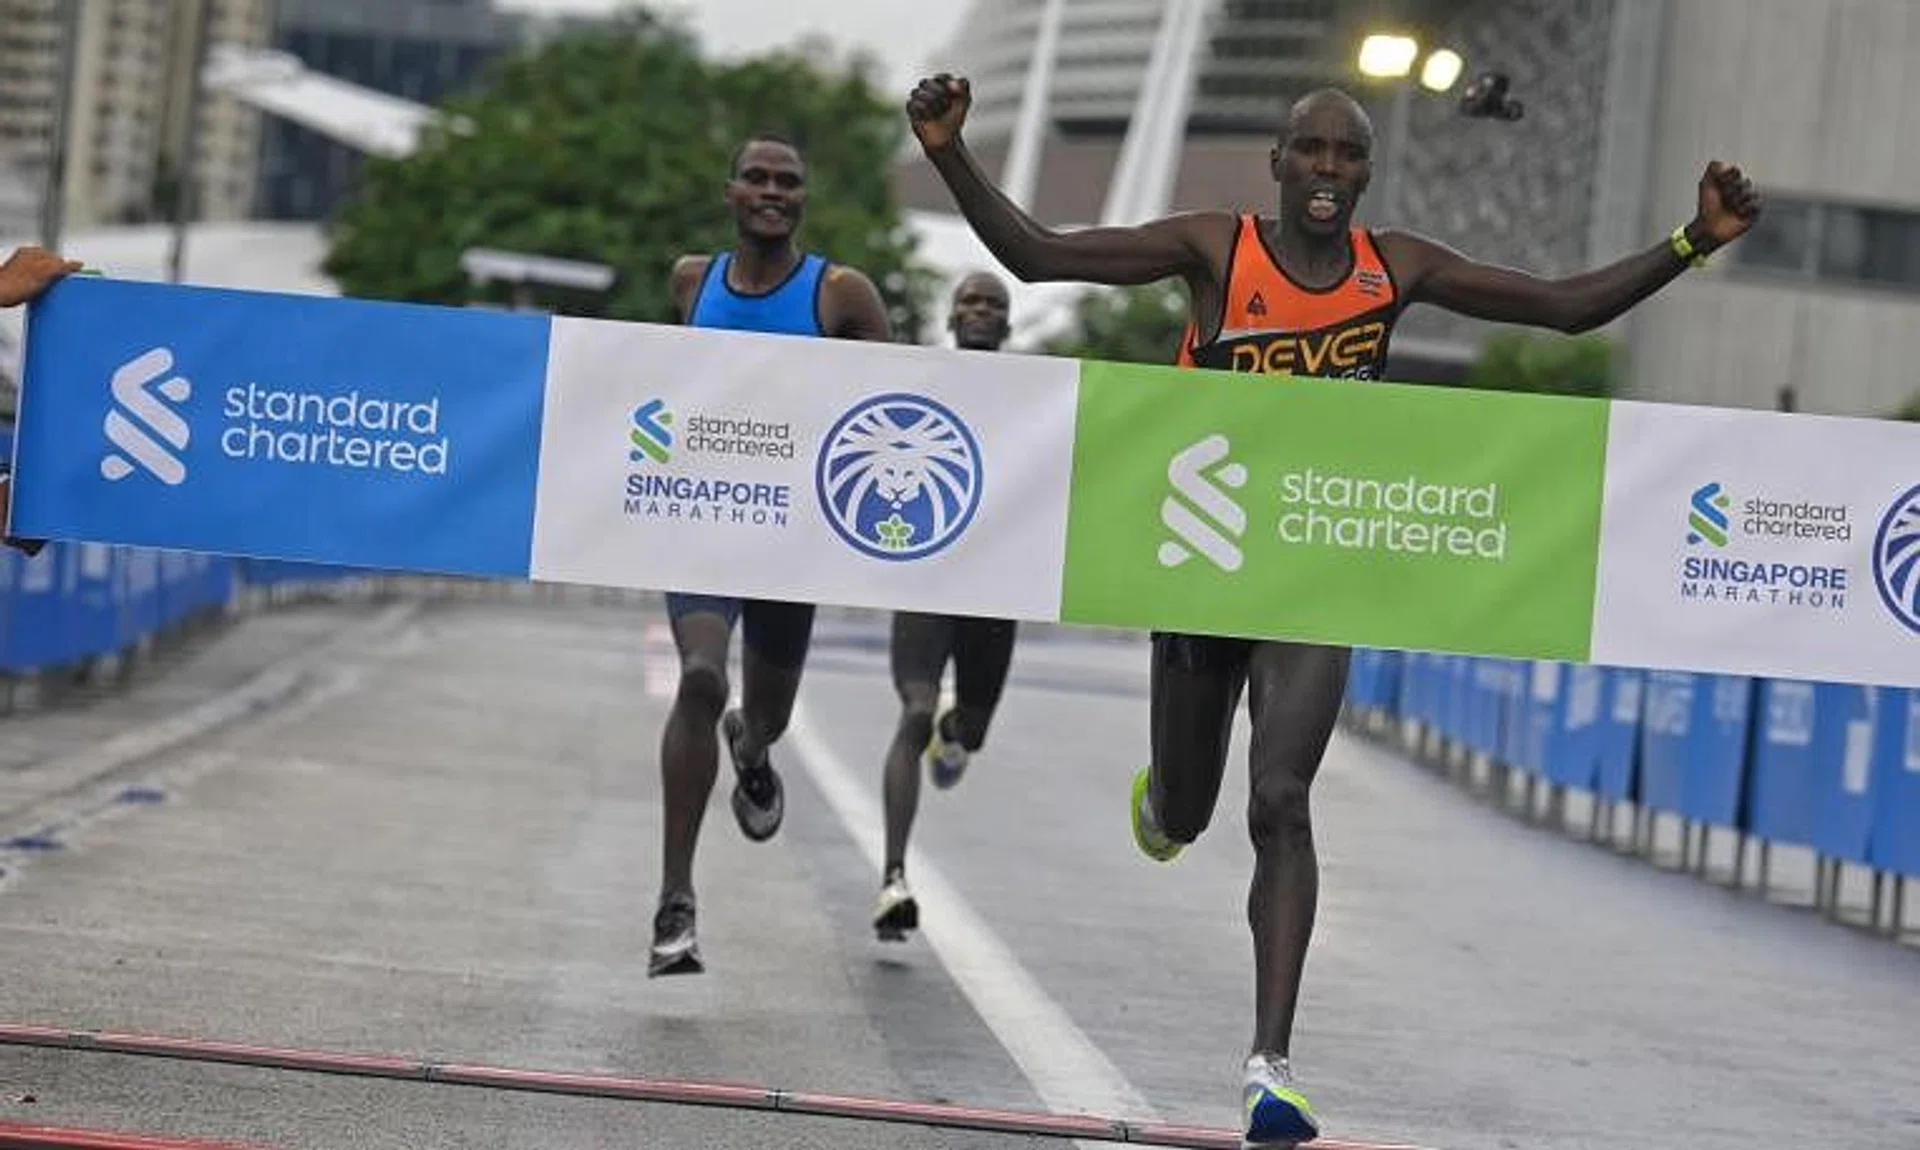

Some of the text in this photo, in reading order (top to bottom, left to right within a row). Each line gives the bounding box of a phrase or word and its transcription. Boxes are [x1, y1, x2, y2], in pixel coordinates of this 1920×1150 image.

[224, 382, 440, 434] standard
[687, 414, 790, 439] standard
[221, 422, 448, 474] chartered
[686, 435, 795, 459] chartered
[626, 474, 789, 507] SINGAPORE
[1281, 468, 1496, 518] standard
[625, 500, 787, 526] MARATHON
[1745, 498, 1846, 522] standard
[1278, 509, 1507, 559] chartered
[1744, 517, 1851, 541] chartered
[1684, 558, 1846, 590] SINGAPORE
[1681, 584, 1844, 608] MARATHON
